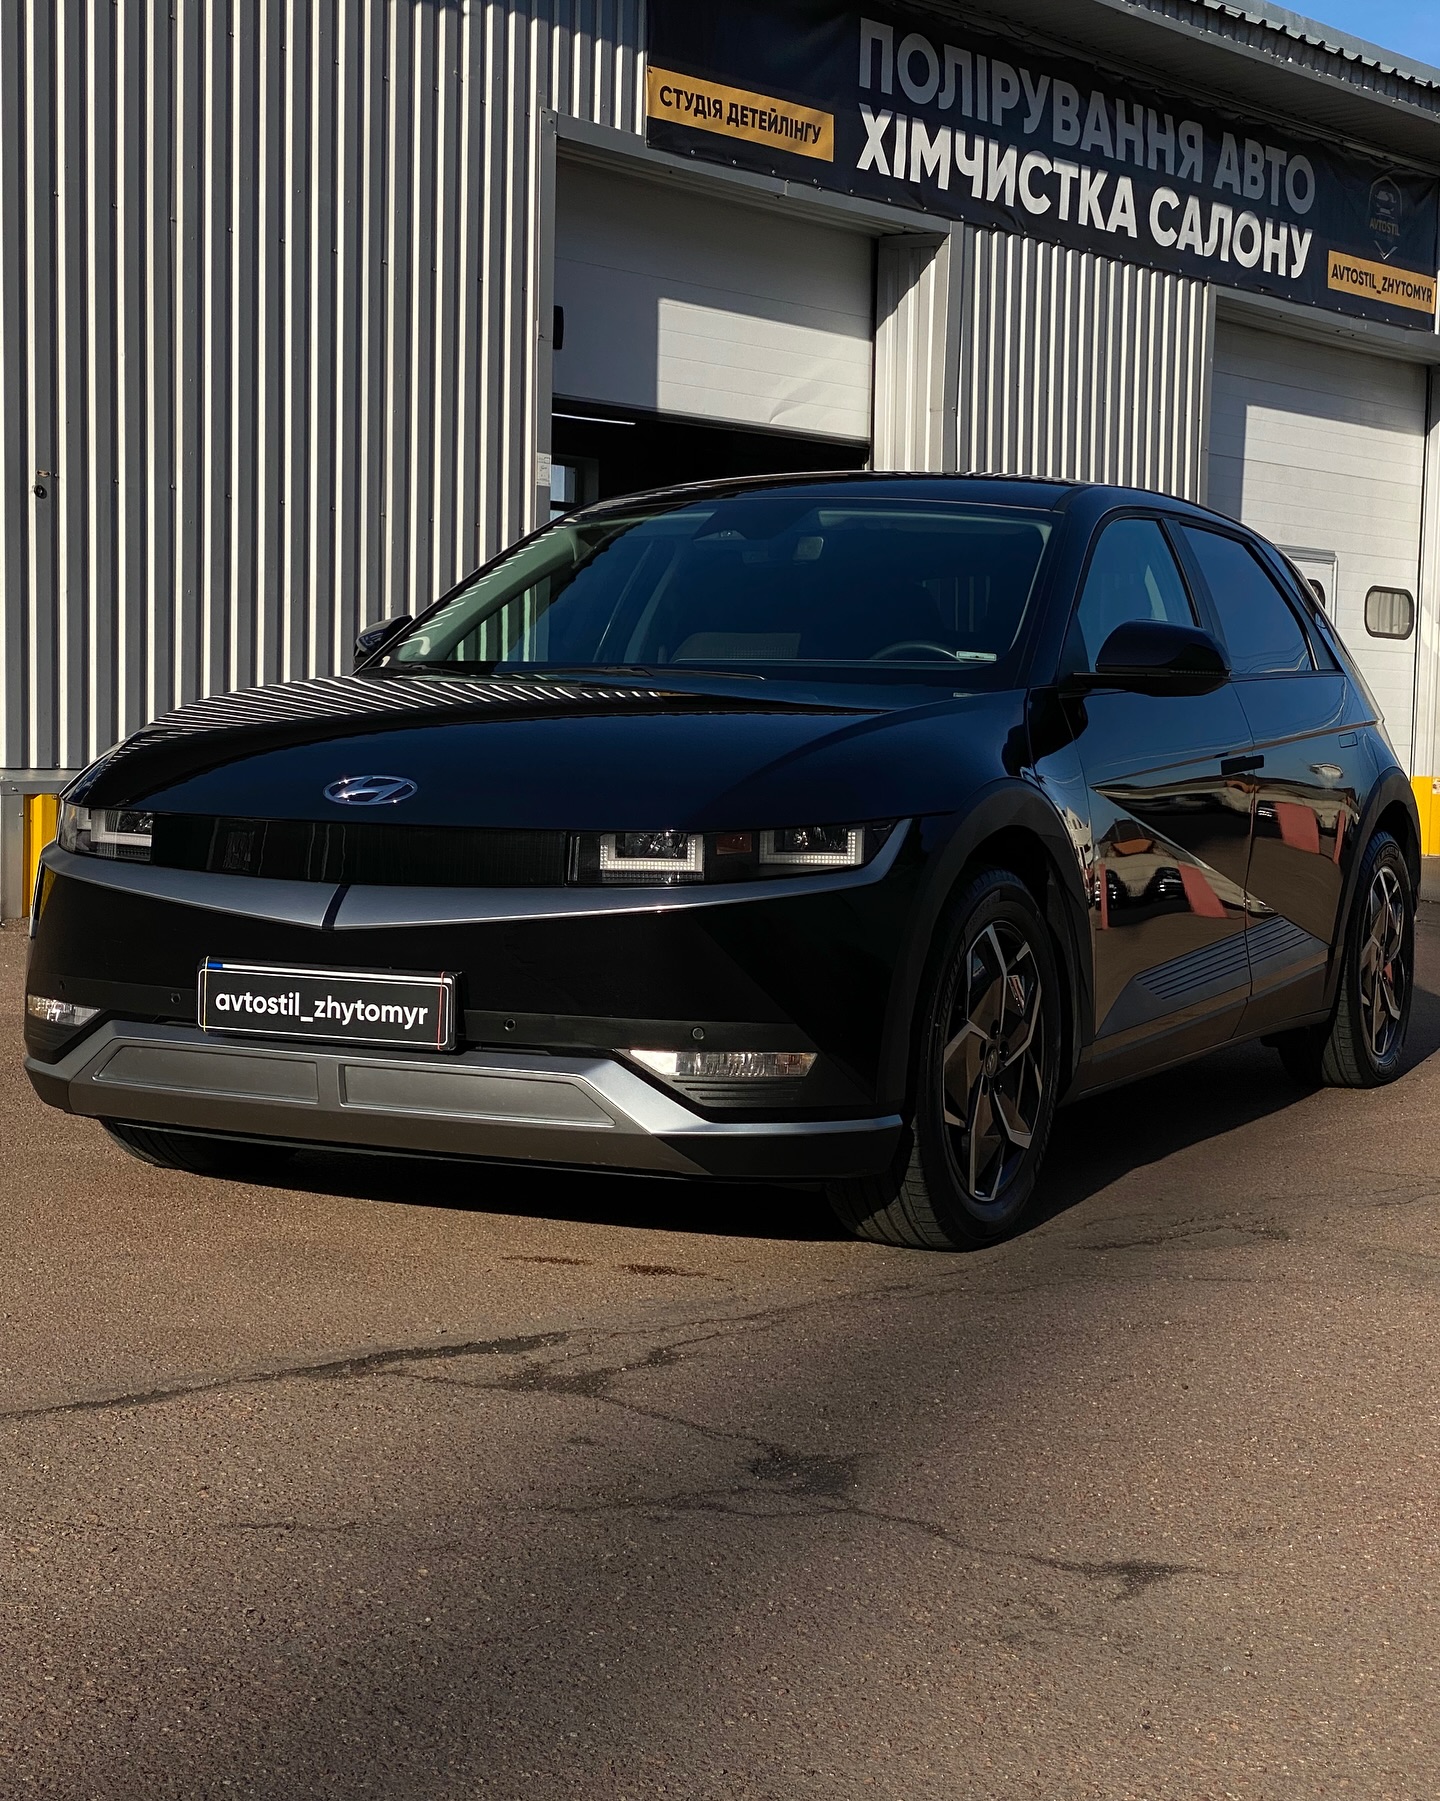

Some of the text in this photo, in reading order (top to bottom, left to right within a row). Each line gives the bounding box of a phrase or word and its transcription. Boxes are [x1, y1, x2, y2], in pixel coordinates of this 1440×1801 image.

[659, 85, 822, 145] СТУДІЯ ДЕТЕЙЛІНГУ
[858, 17, 1316, 215] ПОЛІРУВАННЯ АВТО
[856, 102, 1314, 279] ХІМЧИСТКА САЛОНУ
[1369, 217, 1401, 237] AVTOSTIL
[1331, 263, 1433, 304] AVTOSTIL_ZHYTOMYR
[215, 992, 428, 1030] avtostil_zhytomyr
